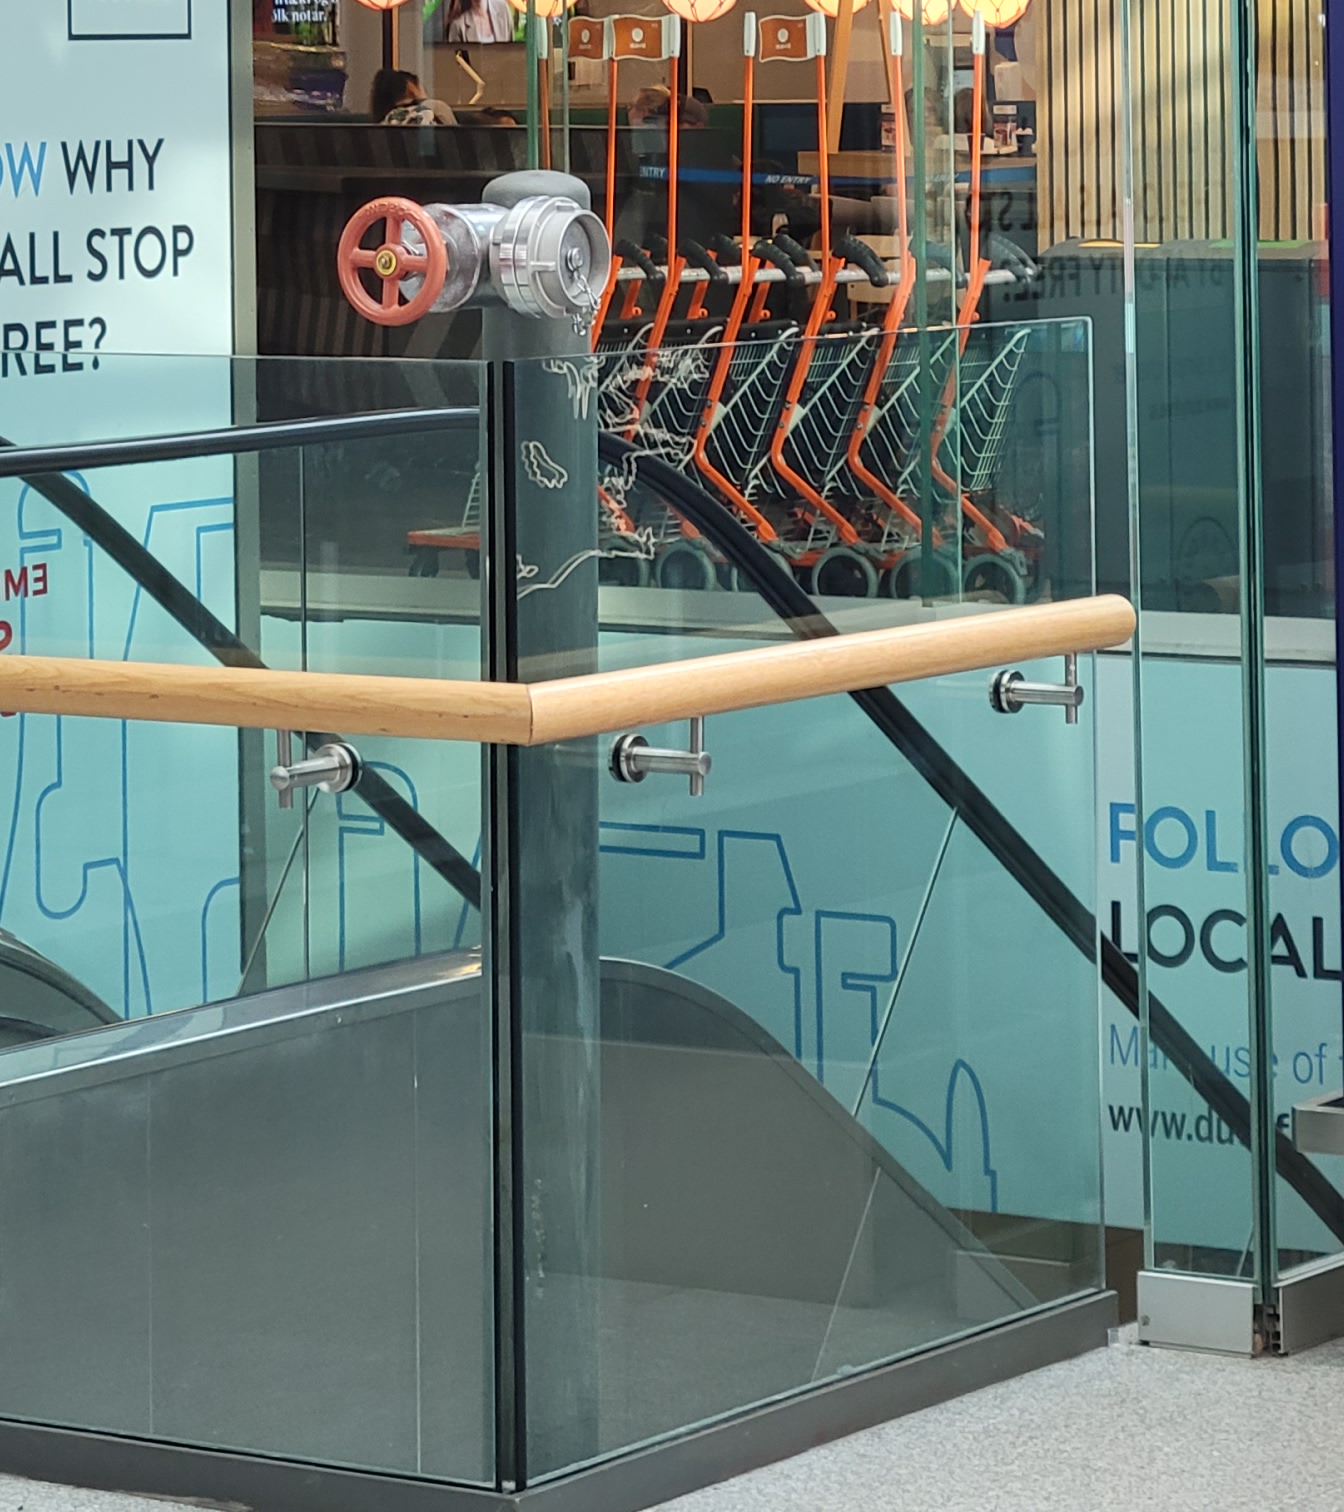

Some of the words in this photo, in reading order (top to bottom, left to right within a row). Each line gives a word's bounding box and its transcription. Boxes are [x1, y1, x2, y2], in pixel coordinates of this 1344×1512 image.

[60, 137, 165, 196] WHY
[86, 224, 194, 282] STOP
[1109, 802, 1340, 879] FOLO
[1211, 1044, 1279, 1079] us
[1293, 1042, 1328, 1085] of
